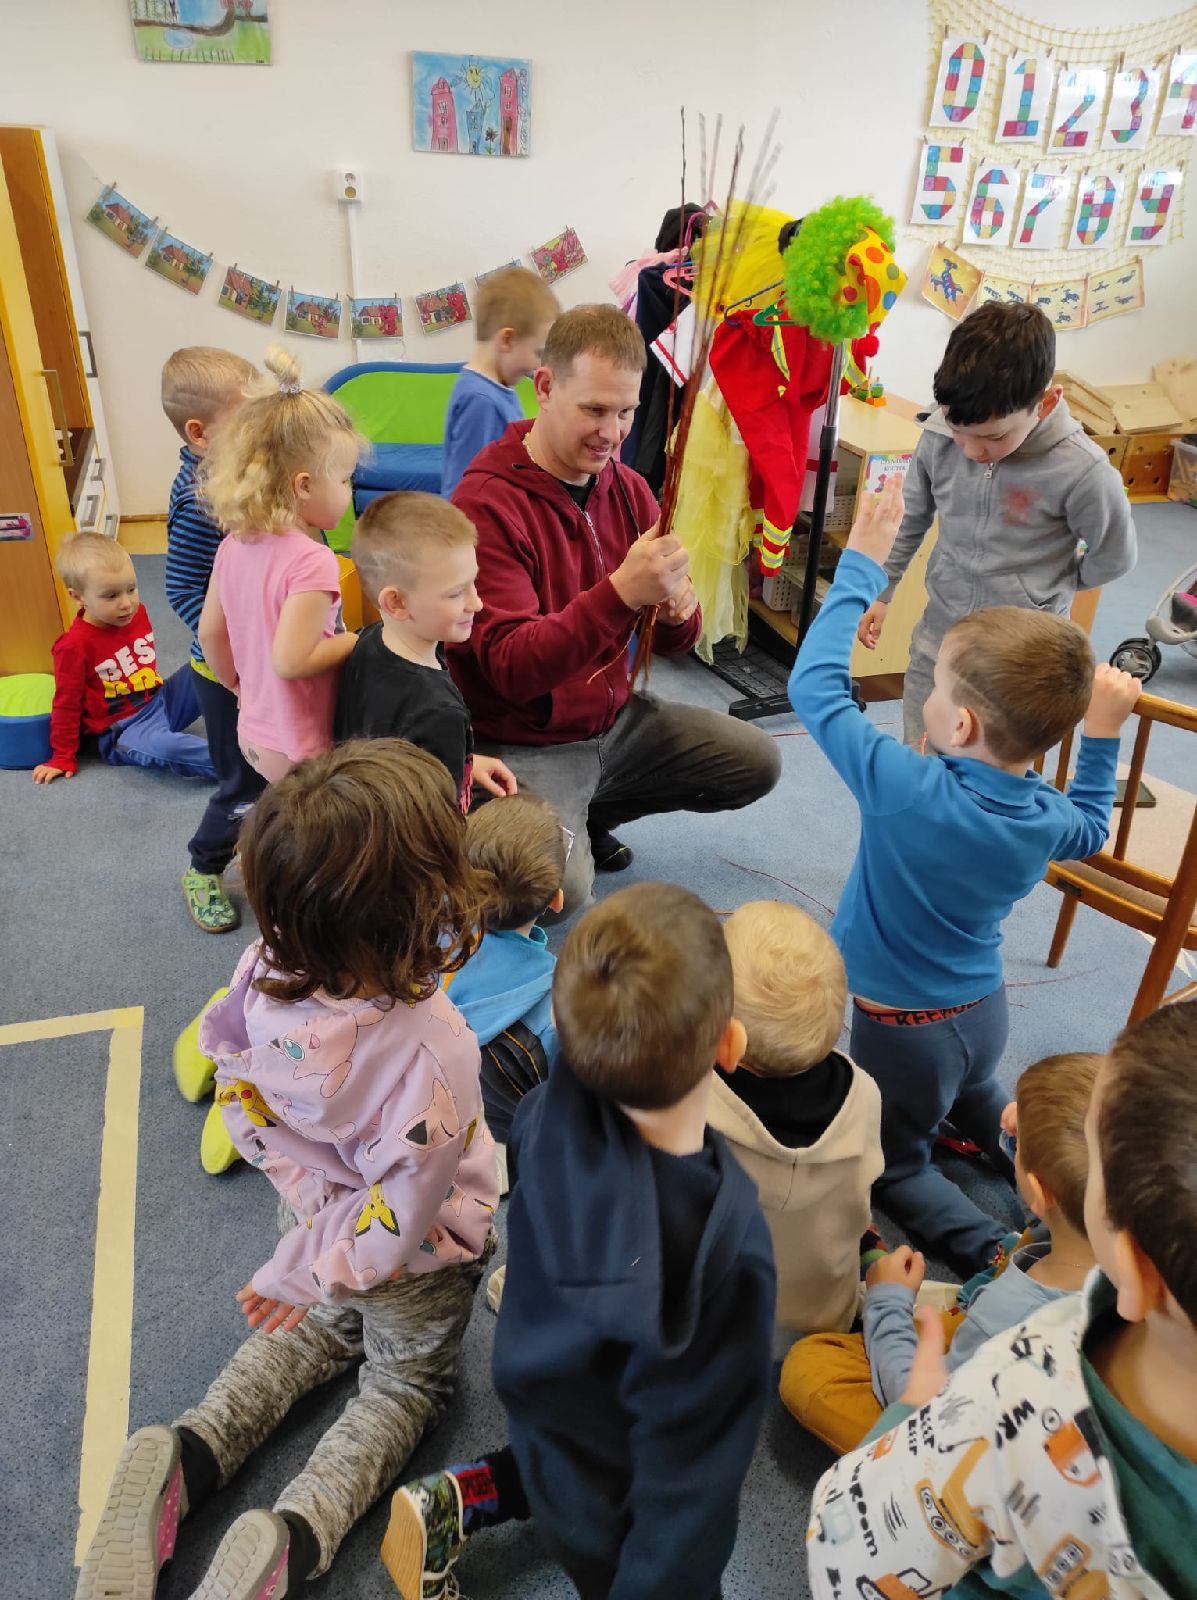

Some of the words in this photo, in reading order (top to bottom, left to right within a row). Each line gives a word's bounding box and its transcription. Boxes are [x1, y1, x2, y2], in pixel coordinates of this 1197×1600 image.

[943, 43, 985, 122] 0
[1002, 59, 1039, 137] 1
[1051, 67, 1095, 147] 2
[1111, 68, 1148, 143] 3
[920, 146, 964, 220] 5
[970, 169, 1009, 239] 6
[1019, 173, 1065, 243] 7
[1076, 176, 1117, 245] 8
[1131, 171, 1175, 241] 9
